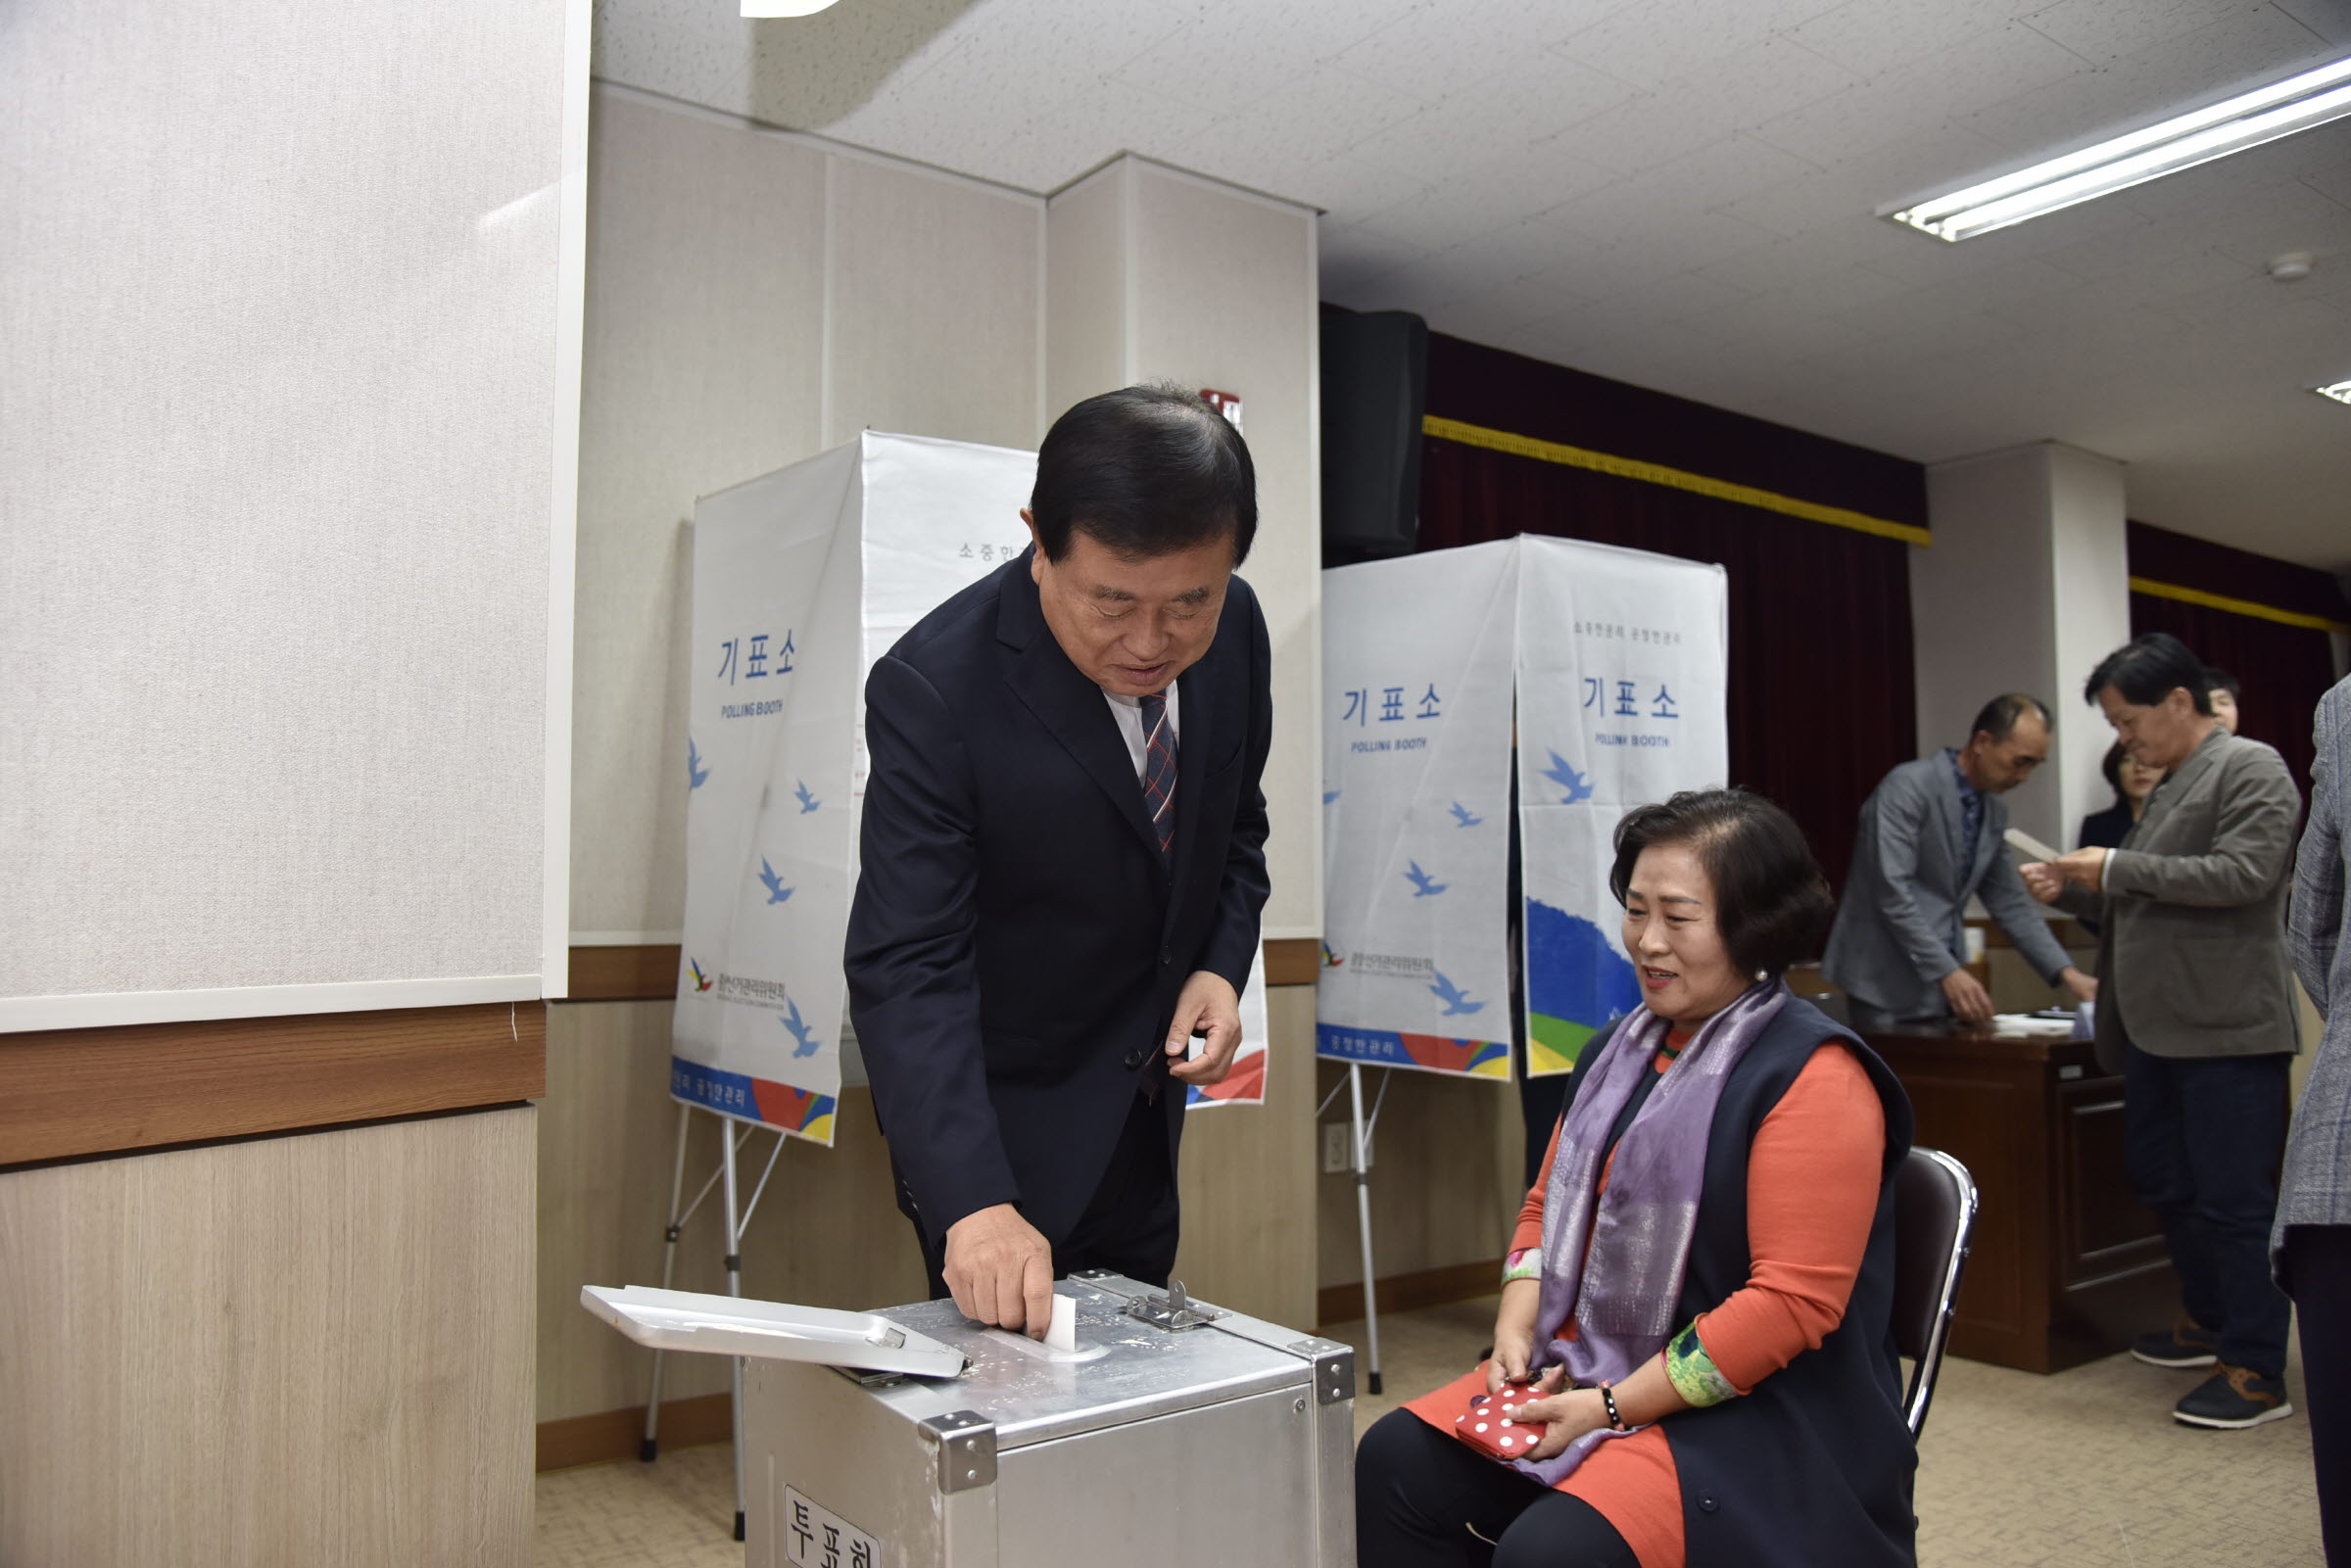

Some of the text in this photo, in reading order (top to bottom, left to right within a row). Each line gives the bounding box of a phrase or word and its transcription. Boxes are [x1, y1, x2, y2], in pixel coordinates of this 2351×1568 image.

[959, 542, 1025, 562] 소중한
[717, 628, 794, 687] 기표소
[1342, 683, 1440, 727] 기표소
[1584, 677, 1679, 719] 기표소
[721, 702, 754, 719] POLLING
[1351, 736, 1427, 753] POLLING BOOTH
[1631, 734, 1669, 747] BOOTH
